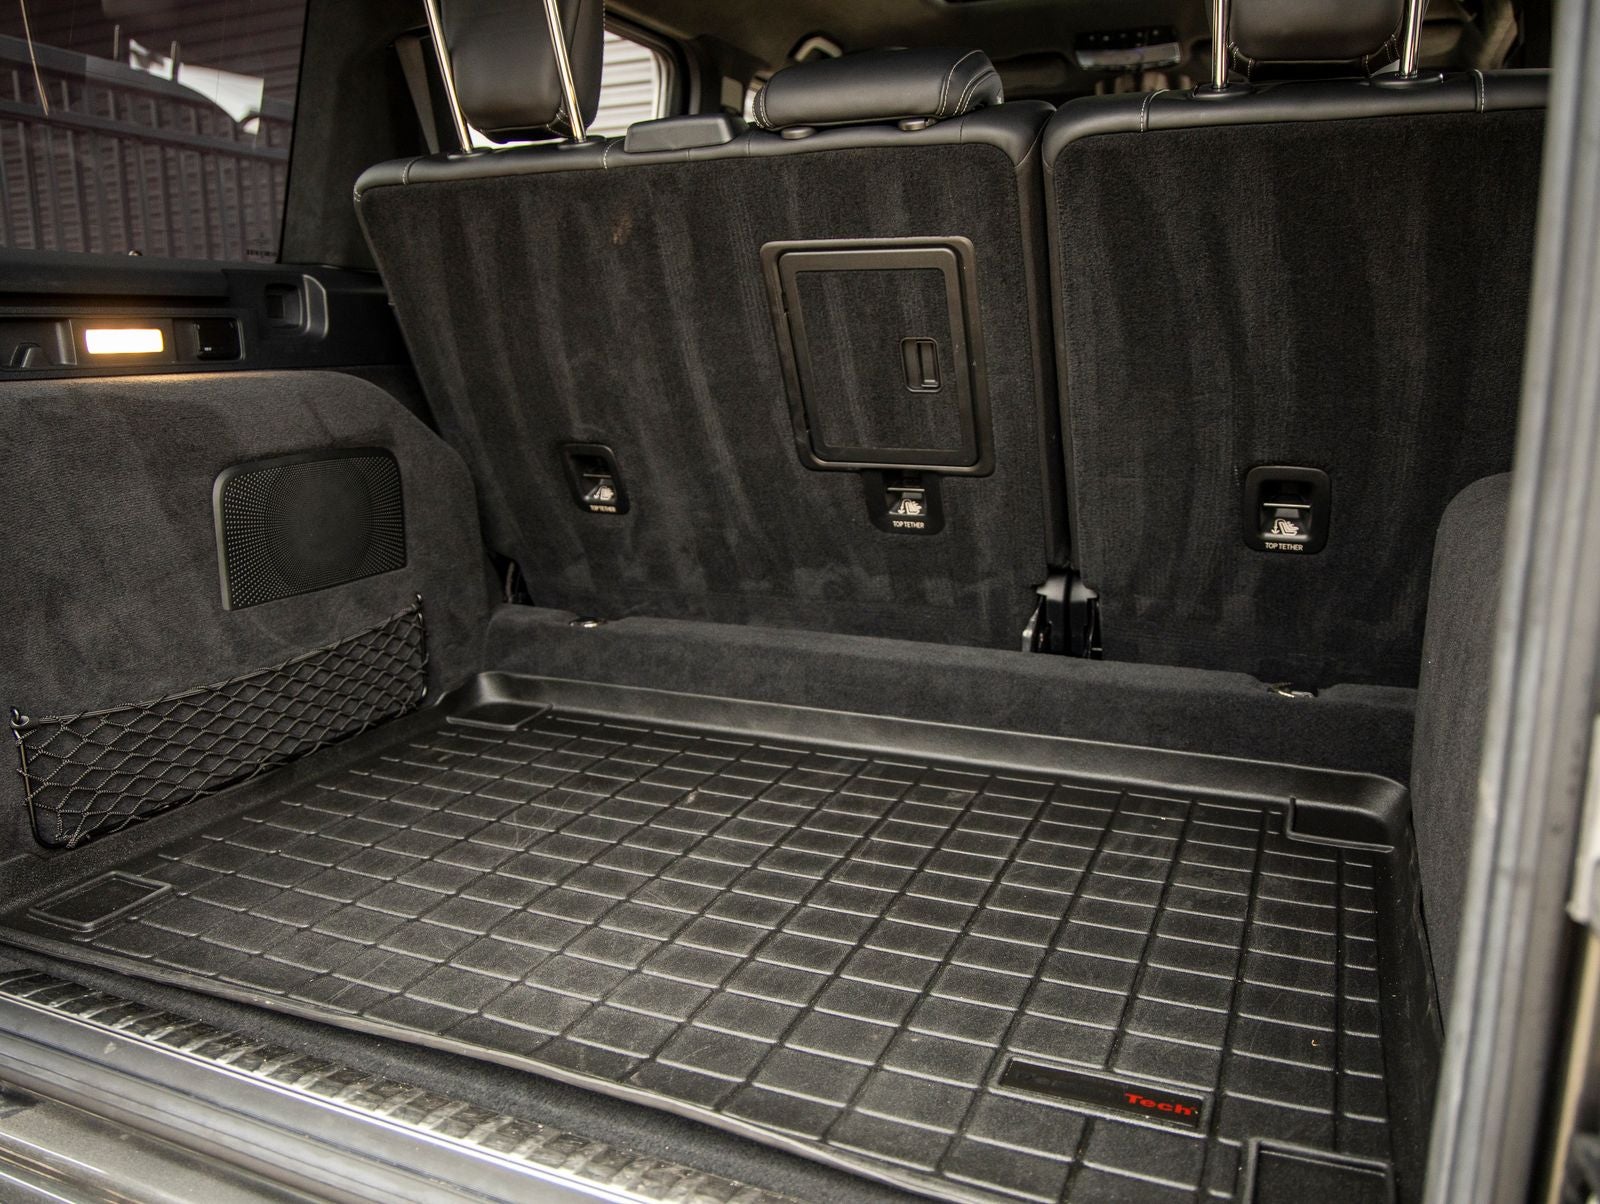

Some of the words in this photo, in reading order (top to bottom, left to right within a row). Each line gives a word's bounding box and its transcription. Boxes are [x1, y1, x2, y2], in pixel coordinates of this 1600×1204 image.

[1265, 542, 1279, 550] TOP
[1279, 543, 1304, 551] TETHER
[1125, 1093, 1192, 1116] Tech
